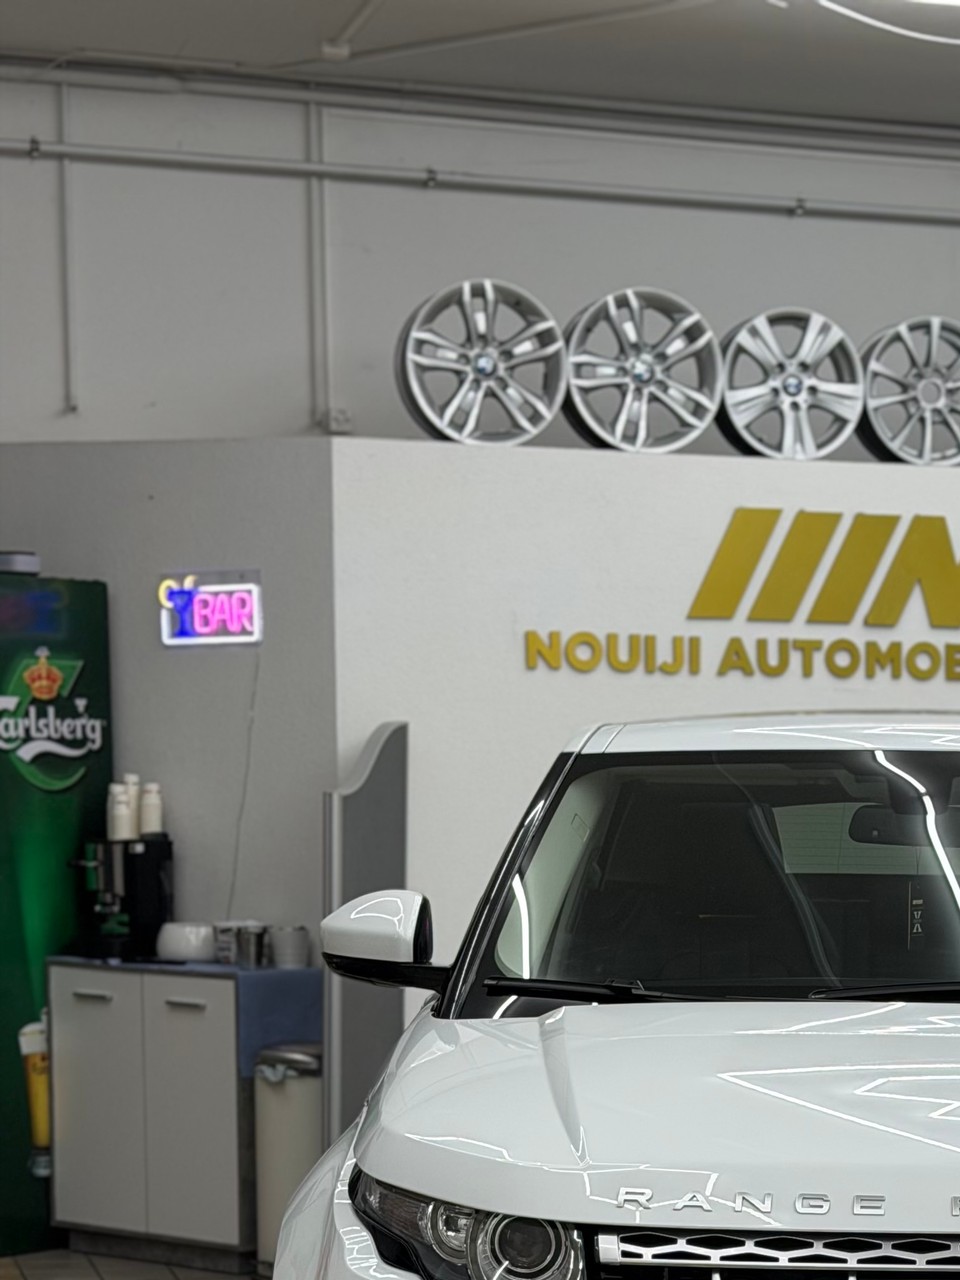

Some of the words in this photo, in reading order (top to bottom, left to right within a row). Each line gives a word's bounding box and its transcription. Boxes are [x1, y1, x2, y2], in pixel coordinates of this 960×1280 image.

[193, 590, 254, 634] BAR
[524, 630, 702, 677] NOUIJI
[616, 1186, 887, 1216] RANGE
